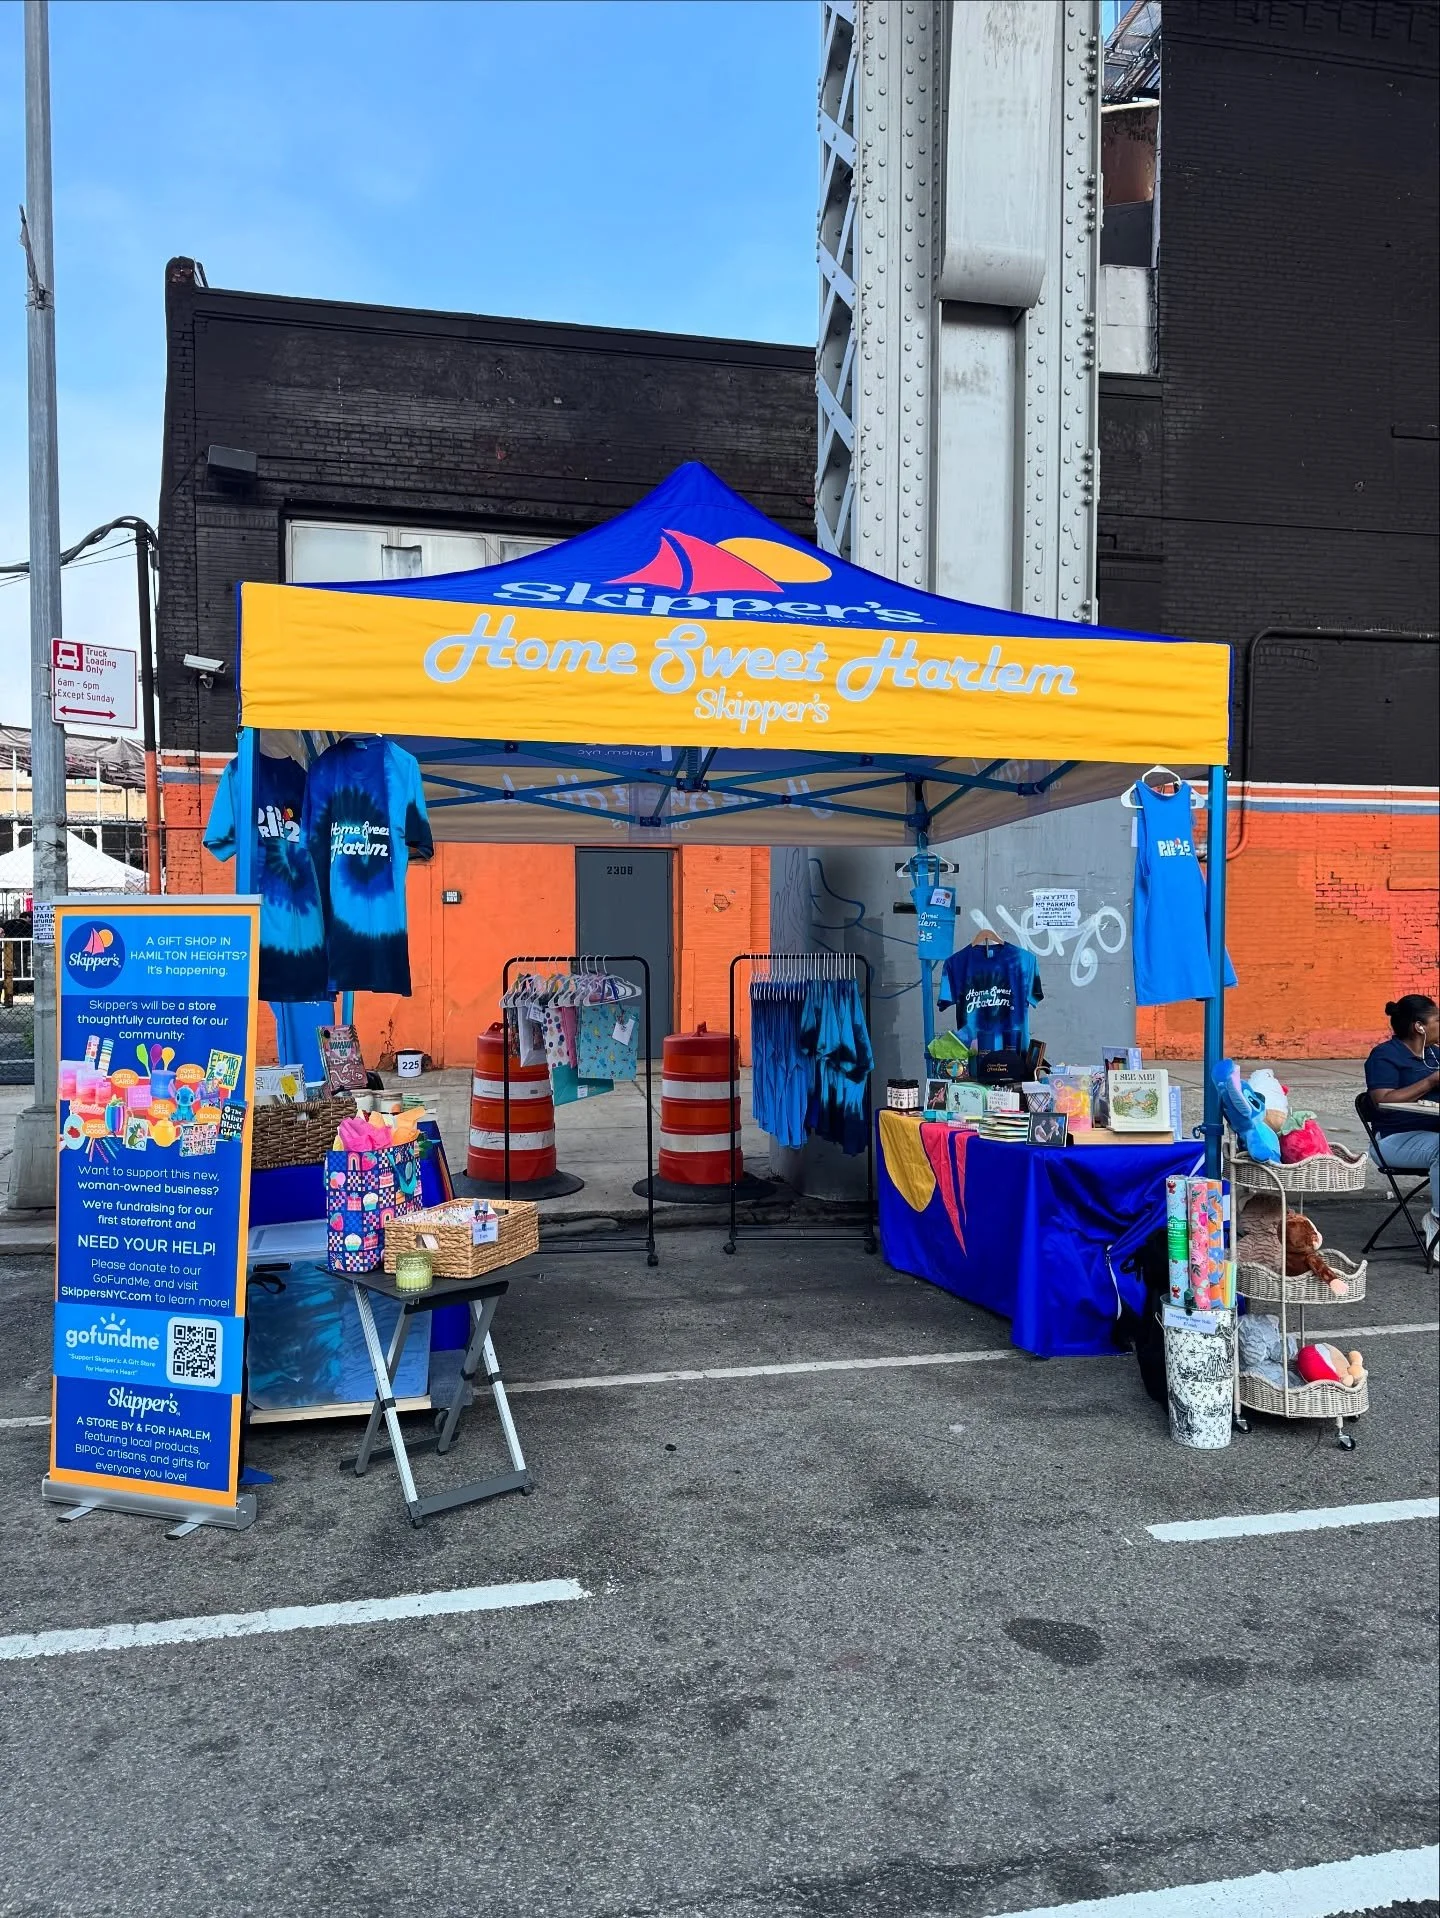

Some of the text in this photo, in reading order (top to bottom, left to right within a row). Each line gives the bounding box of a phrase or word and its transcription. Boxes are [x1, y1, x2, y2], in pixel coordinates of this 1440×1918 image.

[493, 582, 925, 626] Skipper's
[86, 648, 108, 657] Truck
[424, 613, 1077, 702] Home Sweet Harlem
[86, 658, 117, 669] Loading
[86, 666, 104, 675] Only
[58, 679, 75, 688] 6am
[83, 681, 100, 691] 6pm
[57, 690, 115, 704] Except Sunday
[694, 687, 830, 734] Skipper's
[146, 937, 230, 945] A GIFT SHOP IN
[69, 953, 120, 971] Skipper's
[130, 951, 247, 960] HAMILTON HEIGHTS?
[147, 966, 228, 977] It's happening.
[89, 1000, 138, 1011] Skipper's
[141, 1001, 158, 1010] will
[162, 1001, 175, 1010] be
[188, 1002, 216, 1010] store
[77, 1015, 144, 1027] thoughtfully
[147, 1016, 188, 1025] curated
[192, 1017, 206, 1025] for
[119, 1031, 185, 1041] community:
[402, 1060, 419, 1070] 225
[1120, 1073, 1137, 1081] SEE
[1138, 1073, 1155, 1081] ME!
[222, 1113, 244, 1122] Other
[222, 1121, 241, 1130] Black
[78, 1166, 220, 1181] Want to support this new,
[77, 1181, 219, 1195] woman-owned business?
[83, 1200, 213, 1215] We're fundraising for our
[98, 1215, 196, 1229] first storefront and
[78, 1235, 216, 1256] NEED YOUR HELP!
[91, 1259, 201, 1275] Please donate to our
[93, 1274, 198, 1290] GoFundMe, and visit
[61, 1287, 230, 1308] SkippersNYC.com to learn more!
[66, 1325, 160, 1350] gofundme
[108, 1387, 179, 1419] Skipper's
[77, 1416, 211, 1442] A STORE BY & FOR HARLEM,
[85, 1431, 200, 1455] featuring local products,
[76, 1443, 210, 1470] BIPOC artisans, and gifts for
[96, 1461, 187, 1481] everyone you love!
